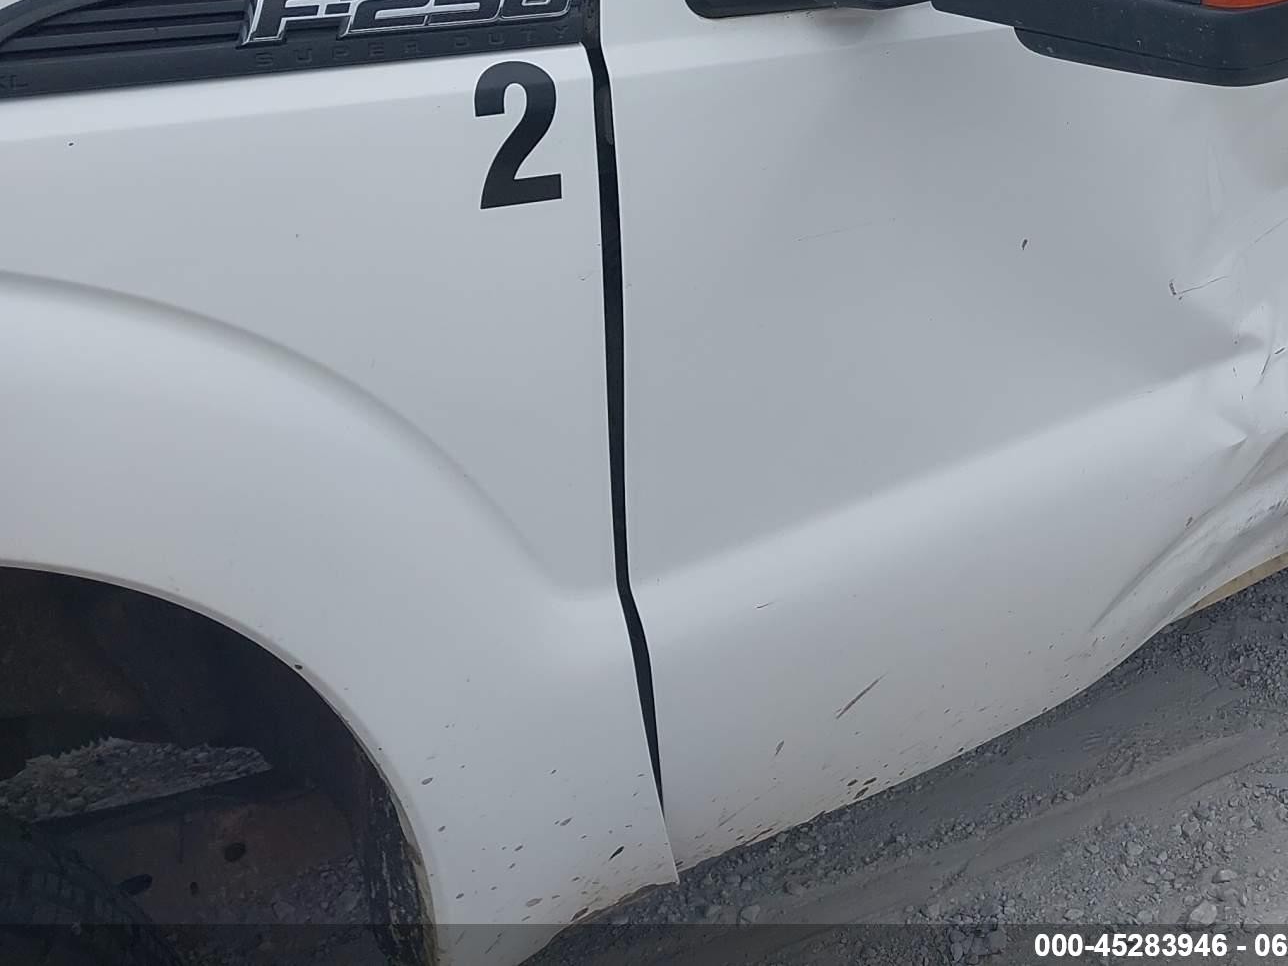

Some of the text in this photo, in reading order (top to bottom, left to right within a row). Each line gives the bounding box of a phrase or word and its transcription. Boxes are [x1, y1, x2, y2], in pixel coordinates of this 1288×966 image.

[256, 26, 570, 67] SUPER DUTY
[474, 60, 563, 210] 2
